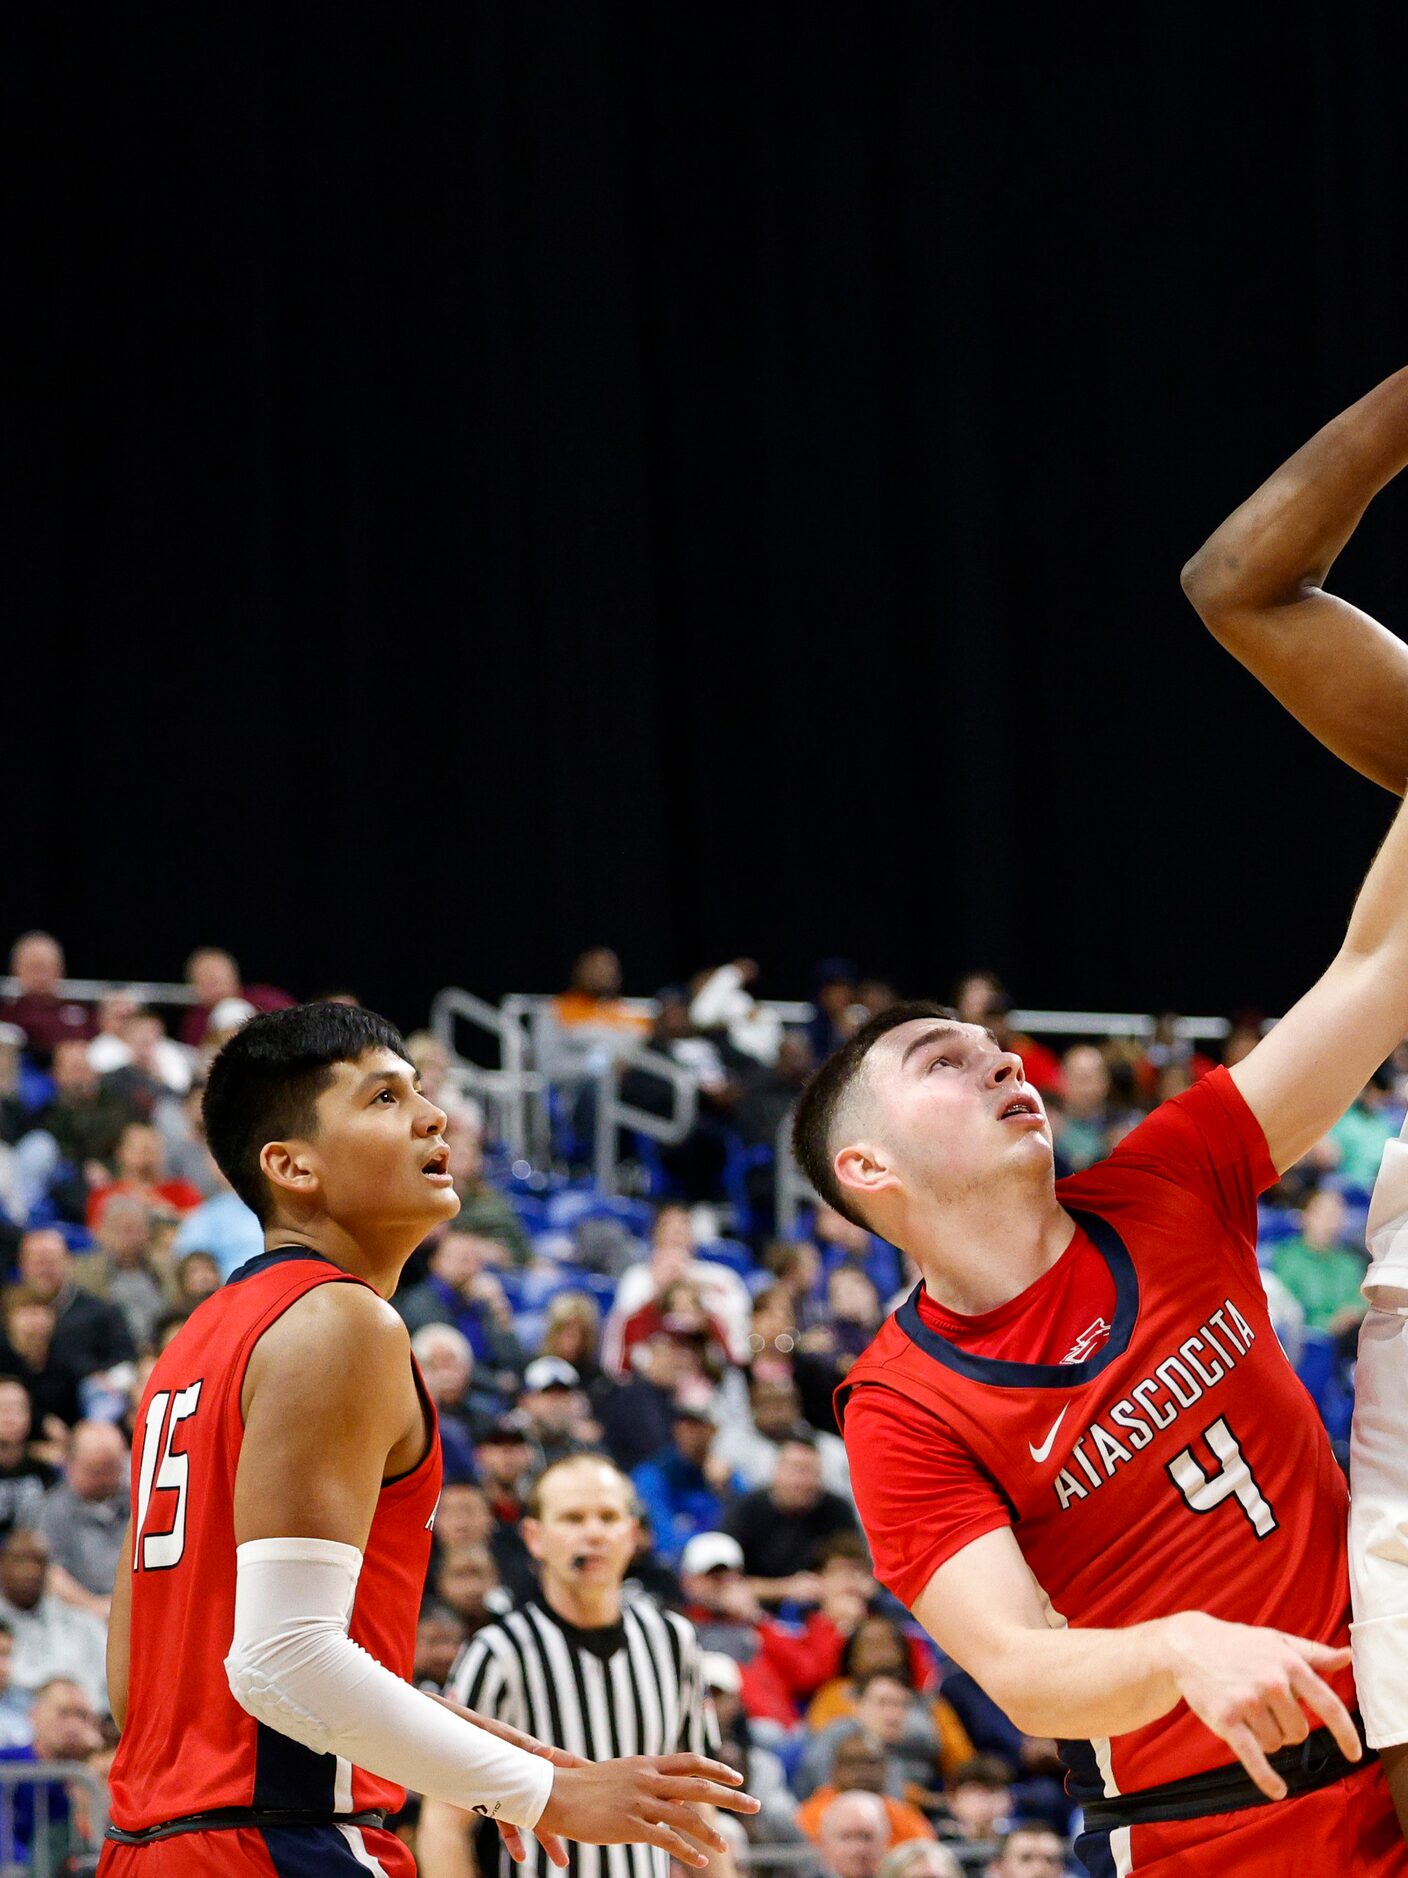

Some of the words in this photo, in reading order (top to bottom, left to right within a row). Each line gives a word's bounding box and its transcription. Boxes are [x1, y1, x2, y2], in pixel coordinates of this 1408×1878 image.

[133, 1378, 204, 1573] 15
[1053, 1299, 1255, 1510] ATASCOCITA
[1164, 1414, 1279, 1541] 4
